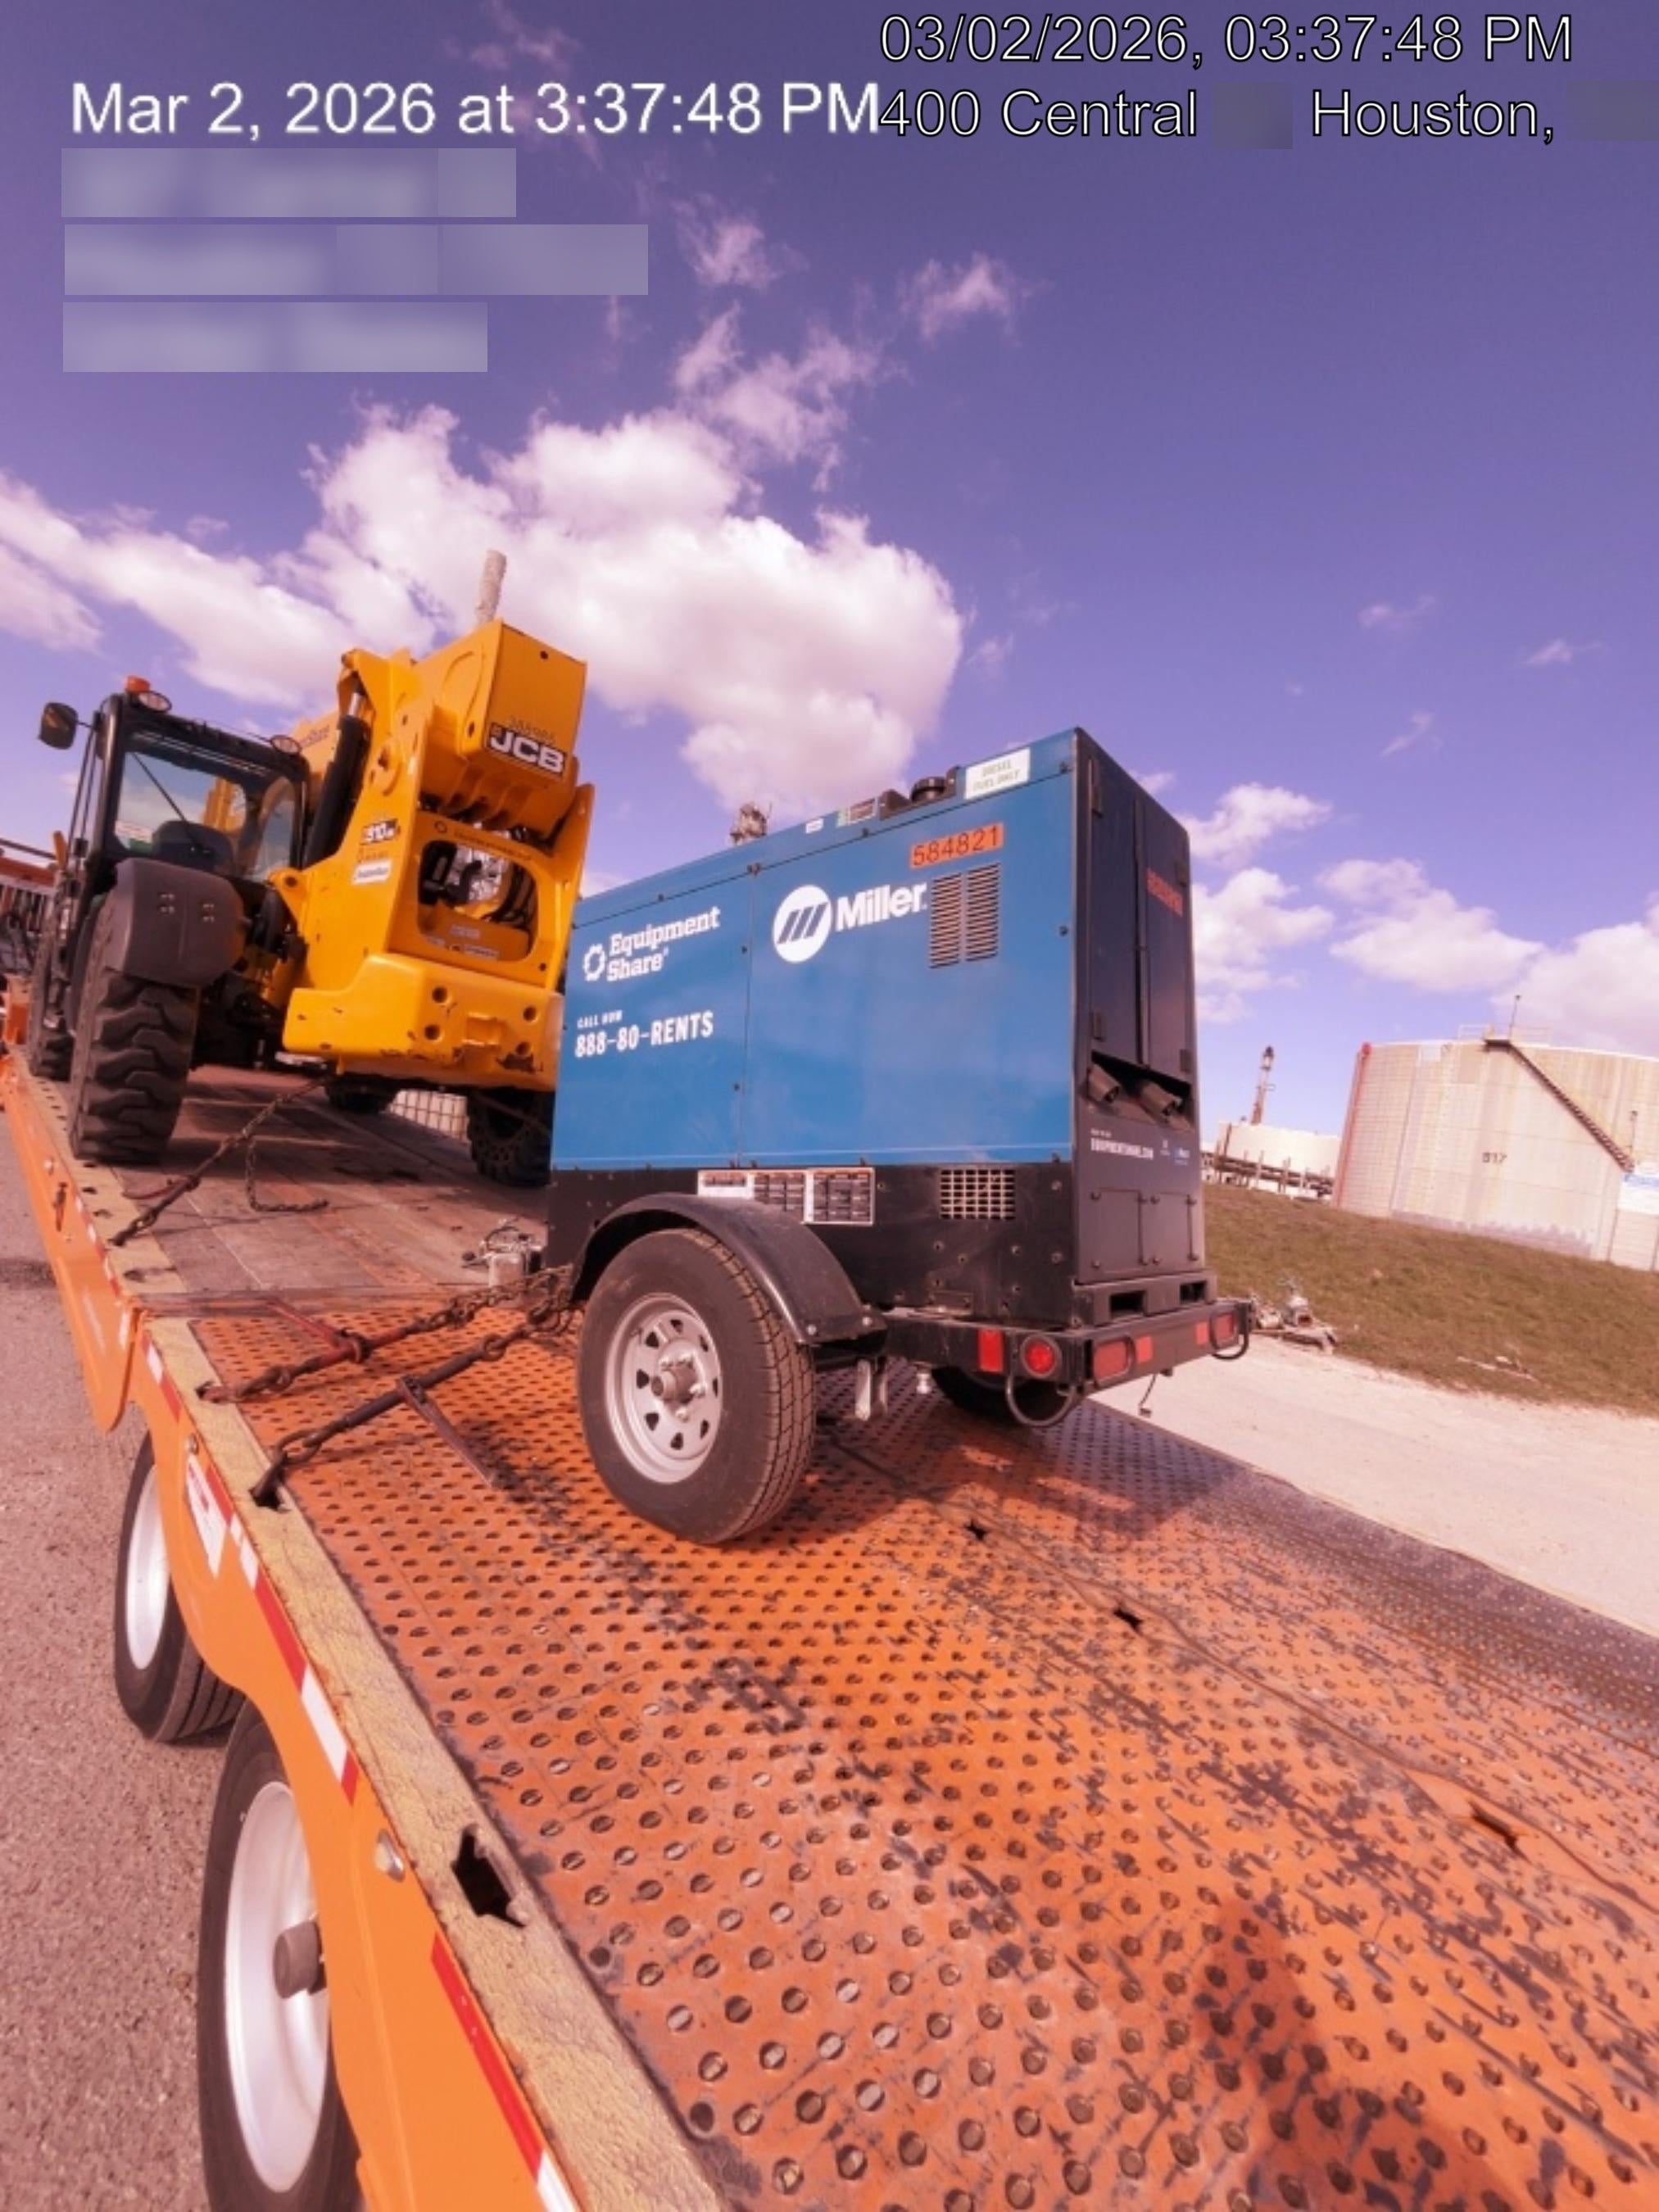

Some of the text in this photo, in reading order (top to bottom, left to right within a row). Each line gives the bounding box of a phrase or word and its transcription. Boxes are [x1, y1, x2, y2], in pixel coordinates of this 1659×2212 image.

[490, 730, 564, 773] JCB
[913, 824, 998, 867] 584821
[835, 882, 927, 932] Miller
[609, 905, 722, 958] Equipment
[606, 952, 664, 982] Share
[574, 1009, 714, 1058] 888-80-RENTS
